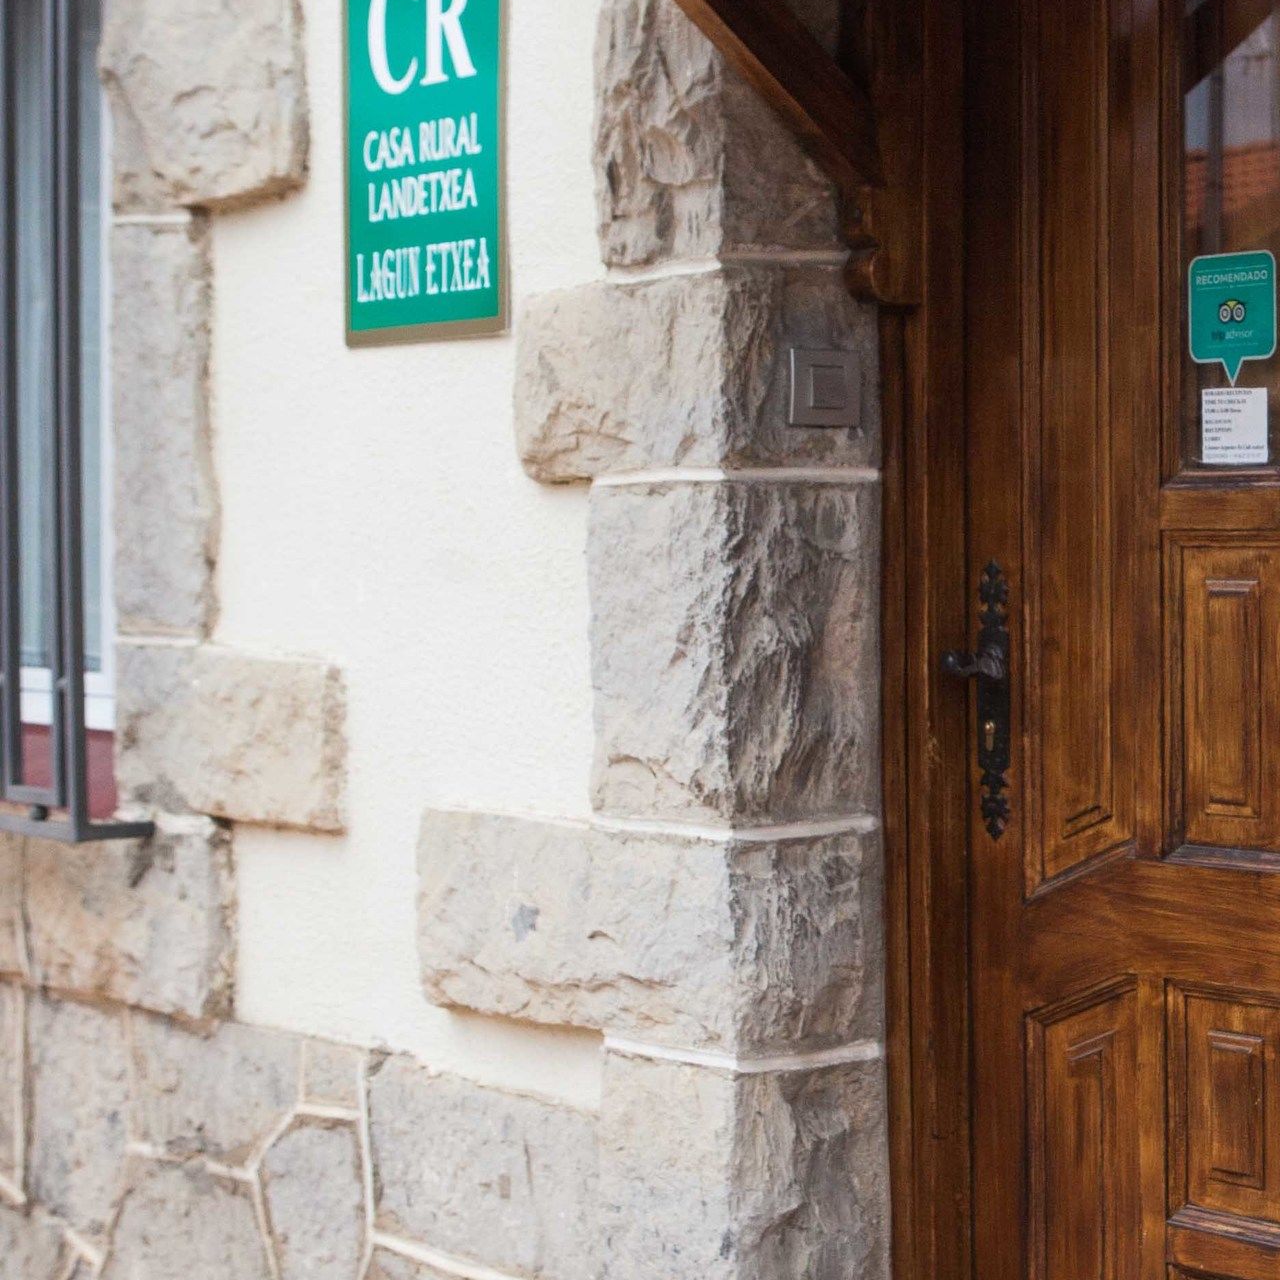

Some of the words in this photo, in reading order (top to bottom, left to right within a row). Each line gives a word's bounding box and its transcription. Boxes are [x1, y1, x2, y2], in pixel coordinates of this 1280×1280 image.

[363, 125, 416, 172] CASA
[418, 112, 482, 163] RURAL
[367, 167, 478, 223] LANDETXEA
[356, 244, 421, 303] LAGUN
[424, 237, 492, 295] ETXEA
[1195, 270, 1268, 286] RECOMENDADO
